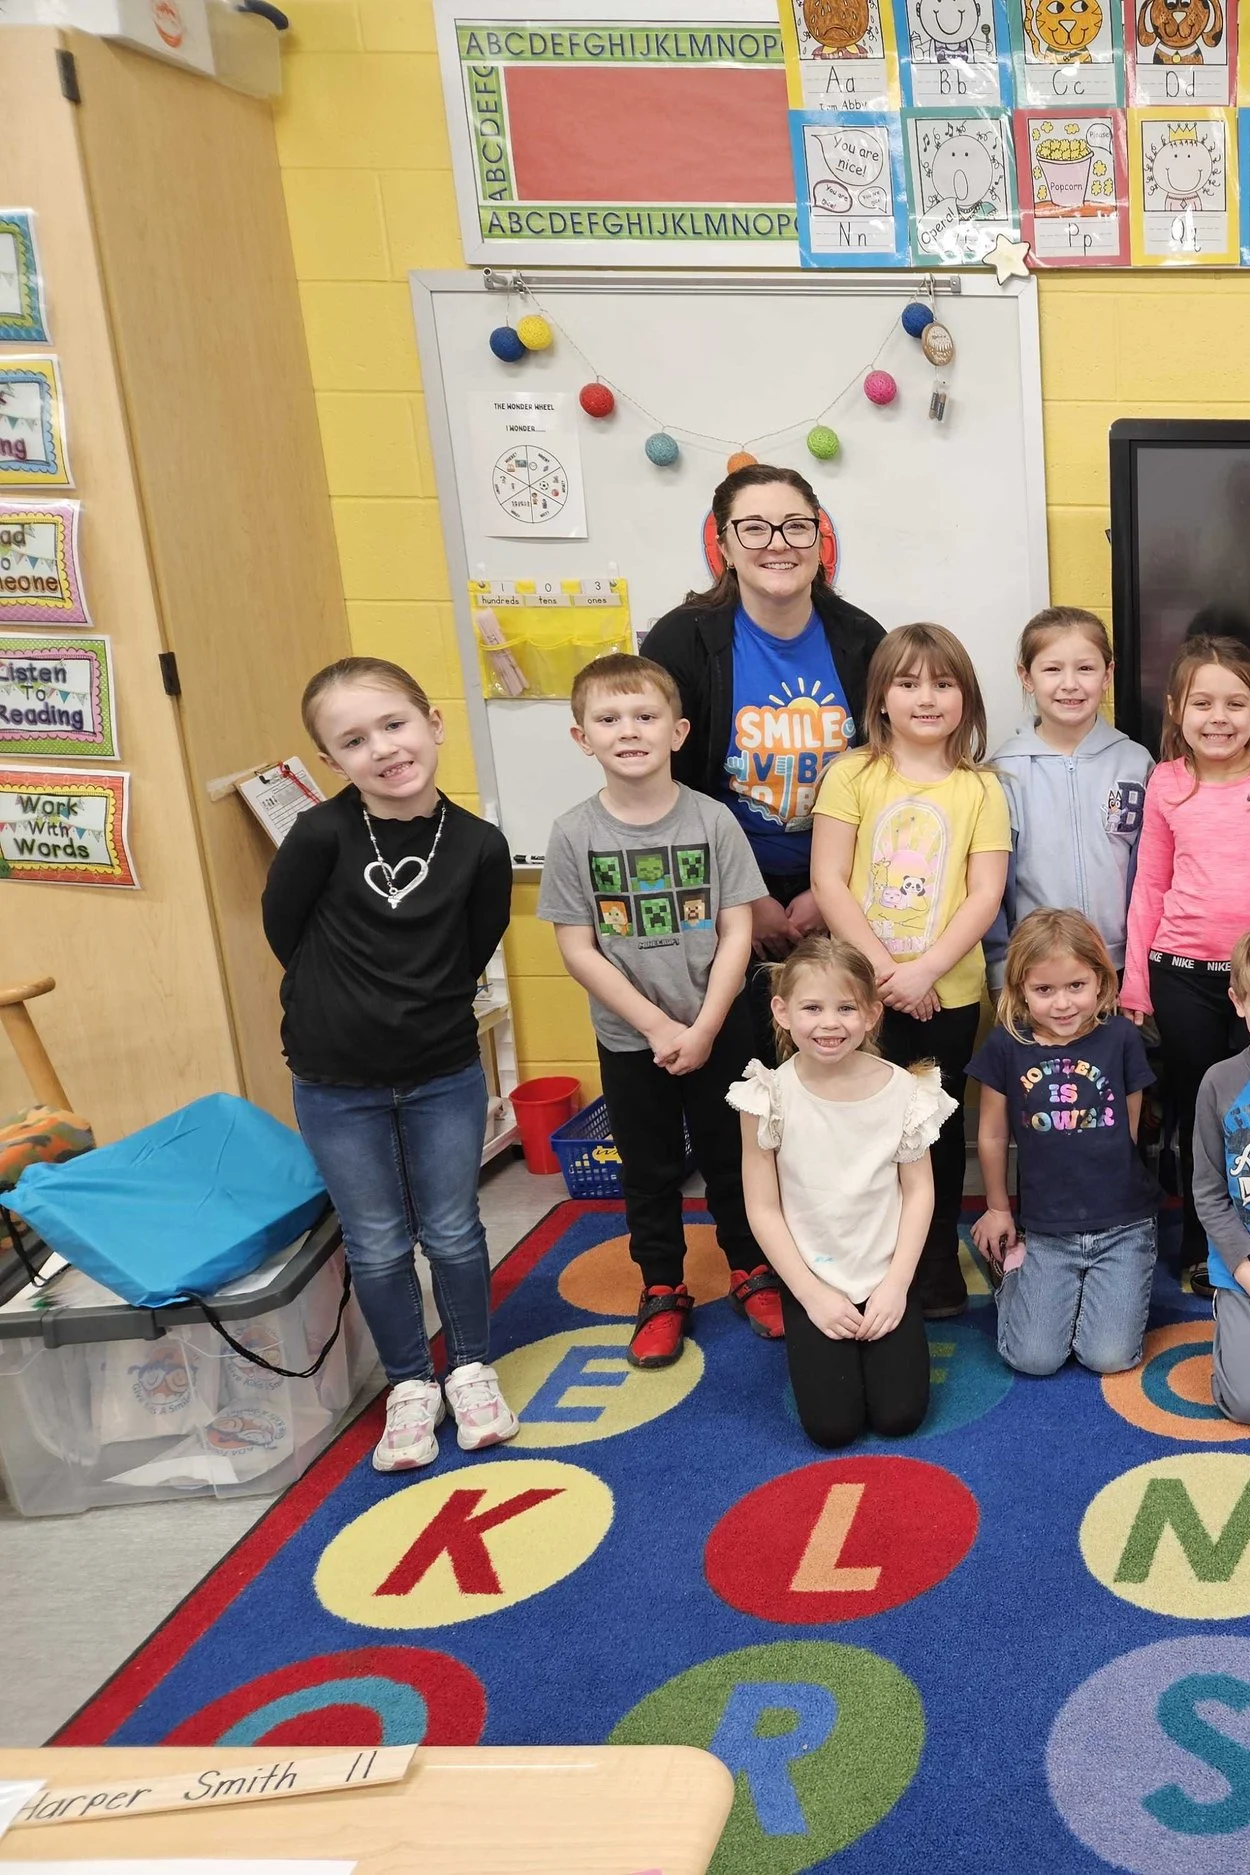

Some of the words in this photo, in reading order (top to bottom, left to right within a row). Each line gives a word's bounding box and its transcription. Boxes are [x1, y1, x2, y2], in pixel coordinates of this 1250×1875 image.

[466, 31, 784, 58] ABCDEFGHIJKLMNOP
[826, 66, 855, 94] Aa
[940, 69, 967, 94] Bb
[1053, 69, 1084, 96] Cc
[1165, 70, 1195, 98] Dd
[834, 136, 856, 154] You
[859, 148, 879, 161] are
[836, 159, 867, 177] nice!
[1050, 182, 1083, 192] Popcorn
[487, 211, 798, 236] ABCDEFGHIJKLMNOP
[839, 222, 866, 246] Nn
[1068, 225, 1092, 249] Pp
[545, 583, 552, 593] 0
[595, 581, 601, 591] 3
[481, 595, 520, 605] hundreds
[25, 684, 46, 702] To
[741, 711, 842, 748] SMILE
[20, 795, 79, 818] Work
[27, 820, 70, 839] With
[14, 838, 91, 860] Words
[1171, 956, 1195, 969] NIKE
[1207, 961, 1231, 972] NIKE
[1048, 1083, 1078, 1104] IS
[522, 1345, 631, 1421] E
[373, 1488, 566, 1597] K
[789, 1483, 882, 1593] L
[708, 1682, 838, 1836] R
[184, 1765, 297, 1801] Smith
